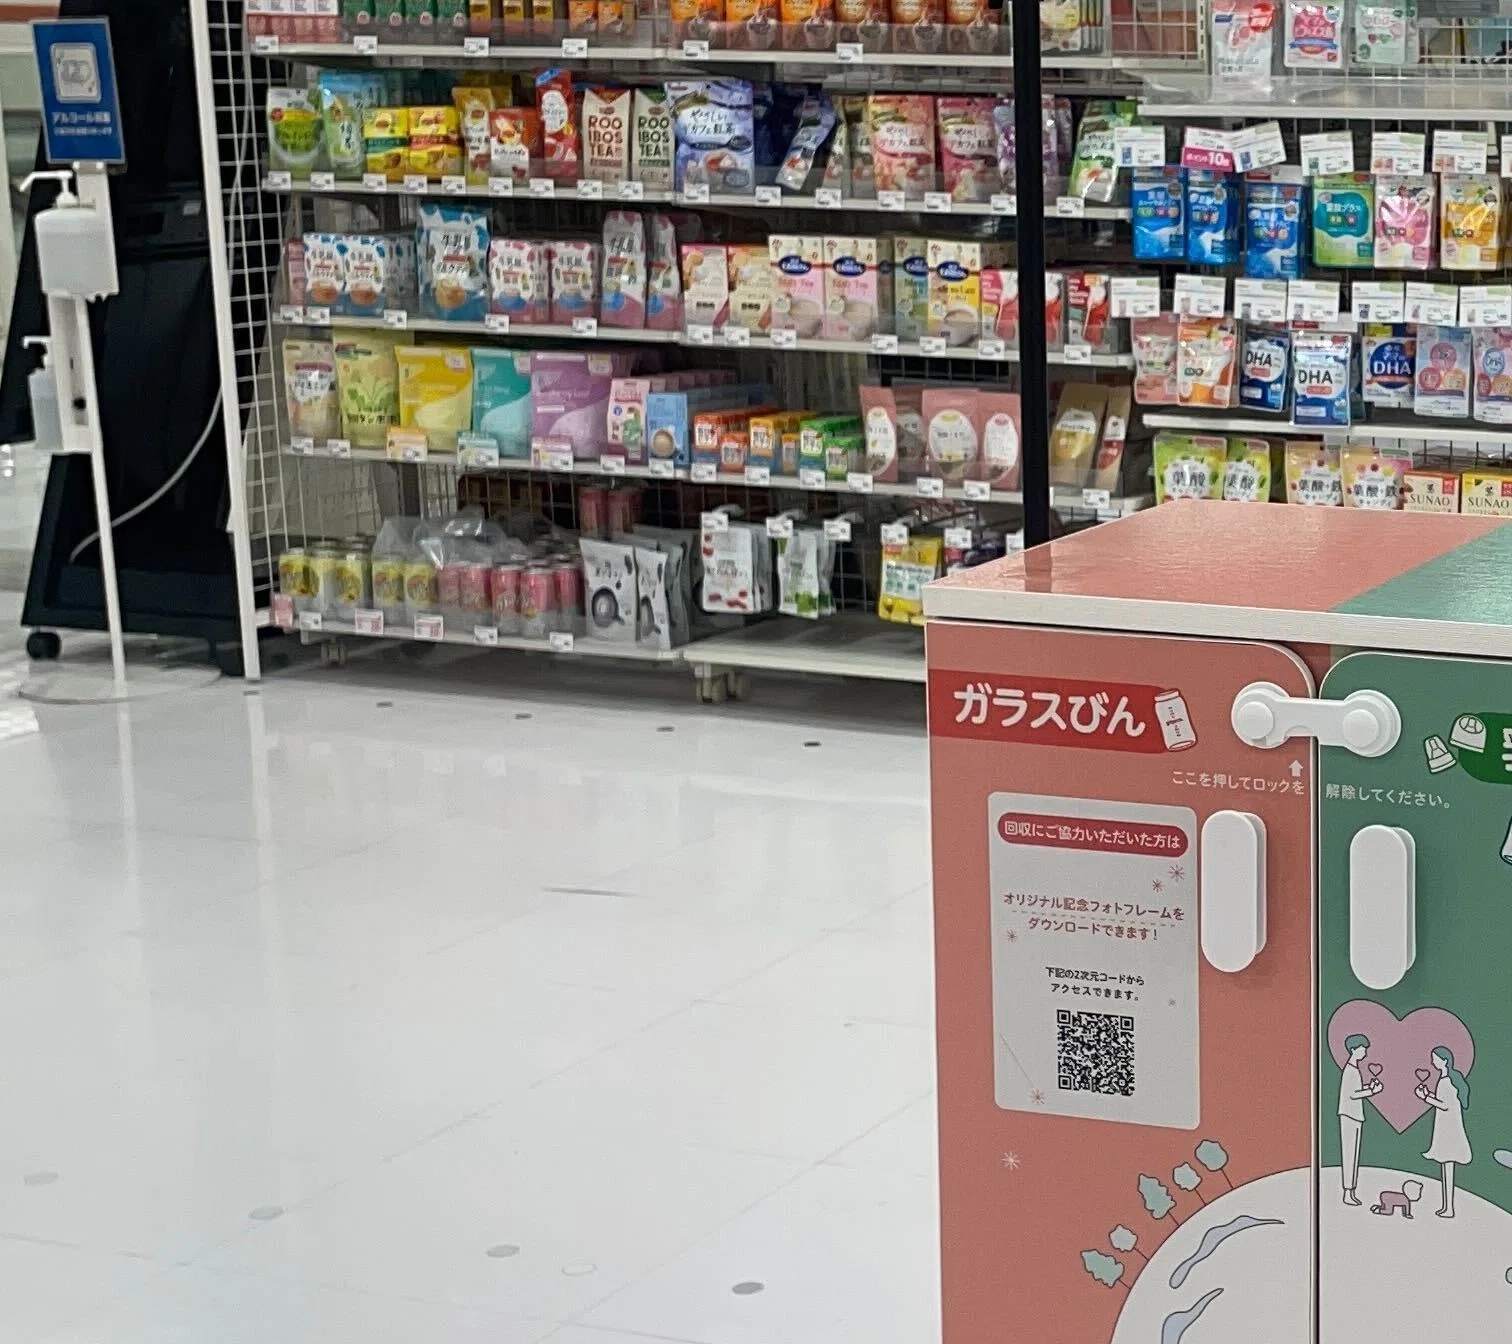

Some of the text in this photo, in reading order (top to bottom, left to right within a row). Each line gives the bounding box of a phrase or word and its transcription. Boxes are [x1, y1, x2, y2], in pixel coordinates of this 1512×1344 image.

[588, 115, 622, 129] ROO
[638, 115, 670, 129] ROO
[590, 143, 614, 156] TEA
[641, 144, 662, 156] TEA
[1246, 350, 1273, 366] DHA
[1373, 360, 1412, 376] DHA
[1298, 369, 1333, 384] DHA
[1409, 493, 1450, 506] SUNAO
[1468, 496, 1510, 509] SUNAO
[953, 682, 1146, 737] ガラスびん
[1172, 770, 1305, 795] ここを押してロックを
[1326, 783, 1451, 808] 解除してください。
[1005, 820, 1180, 849] 回収にご協力いただいた方は
[1003, 892, 1185, 921] オリジナル記念フォトフレームを
[1045, 966, 1145, 987] 下記の2次元コードから
[1049, 983, 1141, 1002] アクセスできます。
